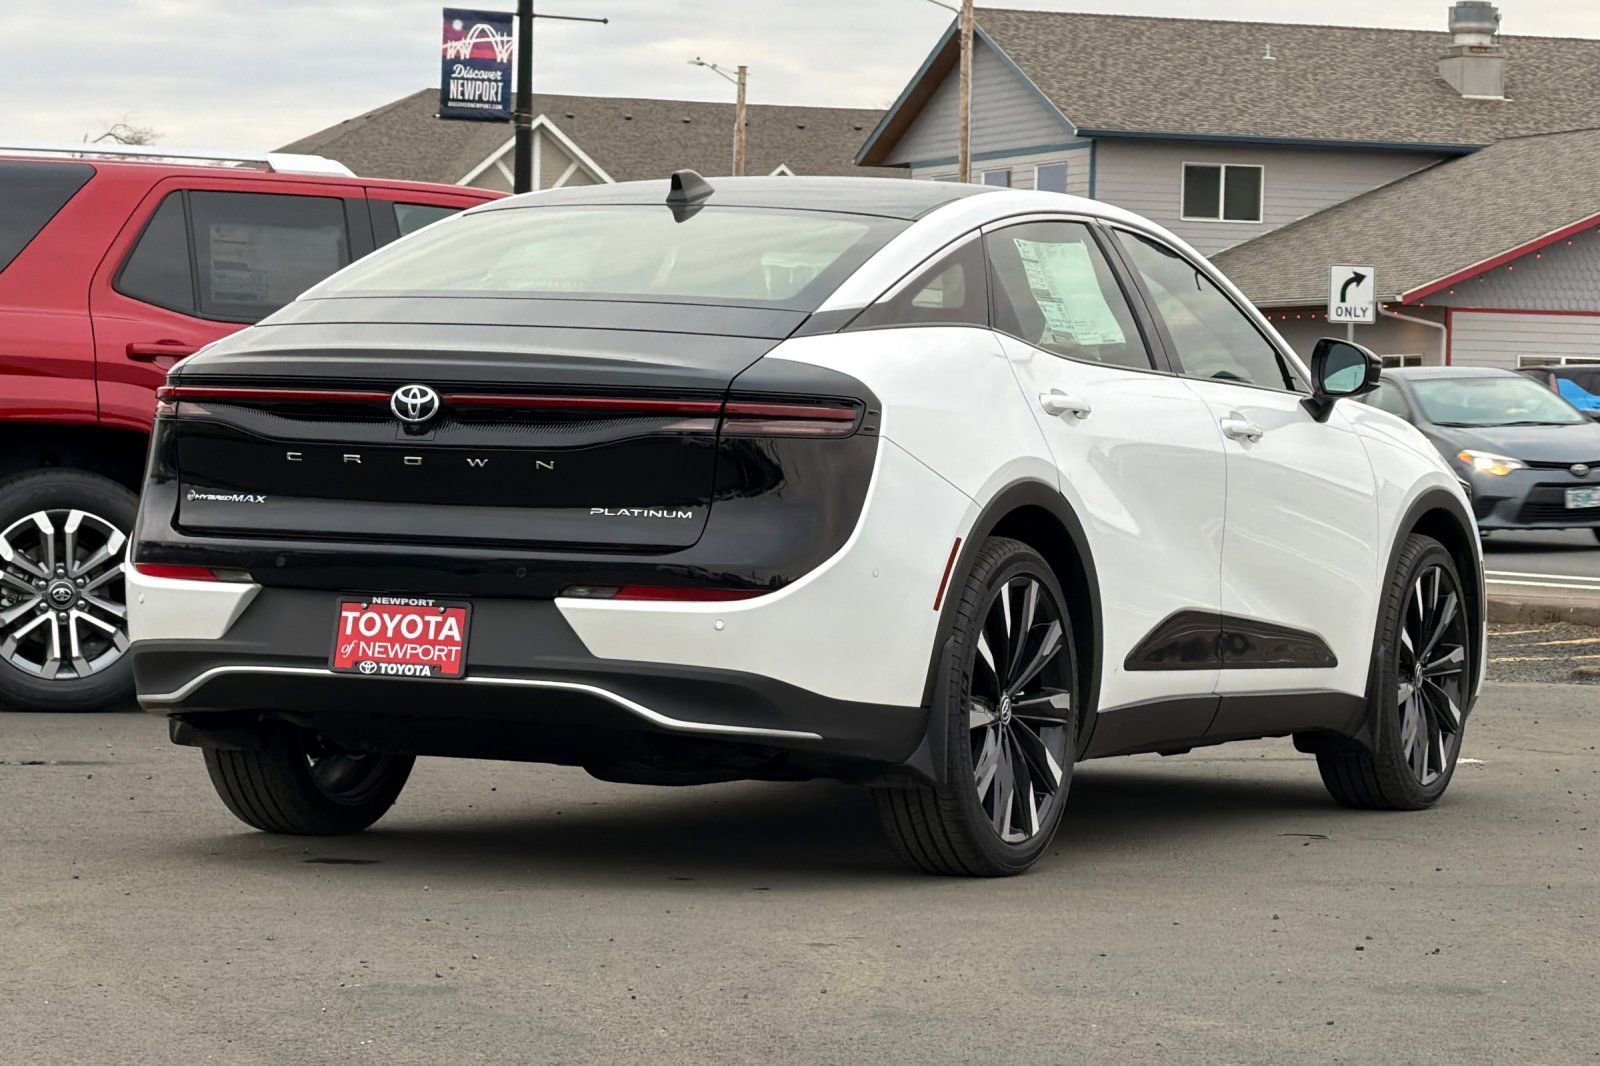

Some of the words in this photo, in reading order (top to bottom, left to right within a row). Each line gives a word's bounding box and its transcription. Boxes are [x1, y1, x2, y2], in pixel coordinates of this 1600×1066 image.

[451, 64, 503, 80] Discover
[449, 79, 504, 102] NEWPORT
[1335, 306, 1369, 319] ONLY
[286, 451, 555, 470] CROWN
[590, 507, 693, 519] PLATINUM
[372, 597, 435, 606] NEWPORT
[341, 611, 462, 642] TOYOTA
[340, 640, 359, 659] of
[358, 640, 462, 662] NEWPORT
[379, 662, 431, 677] TOYOTA
